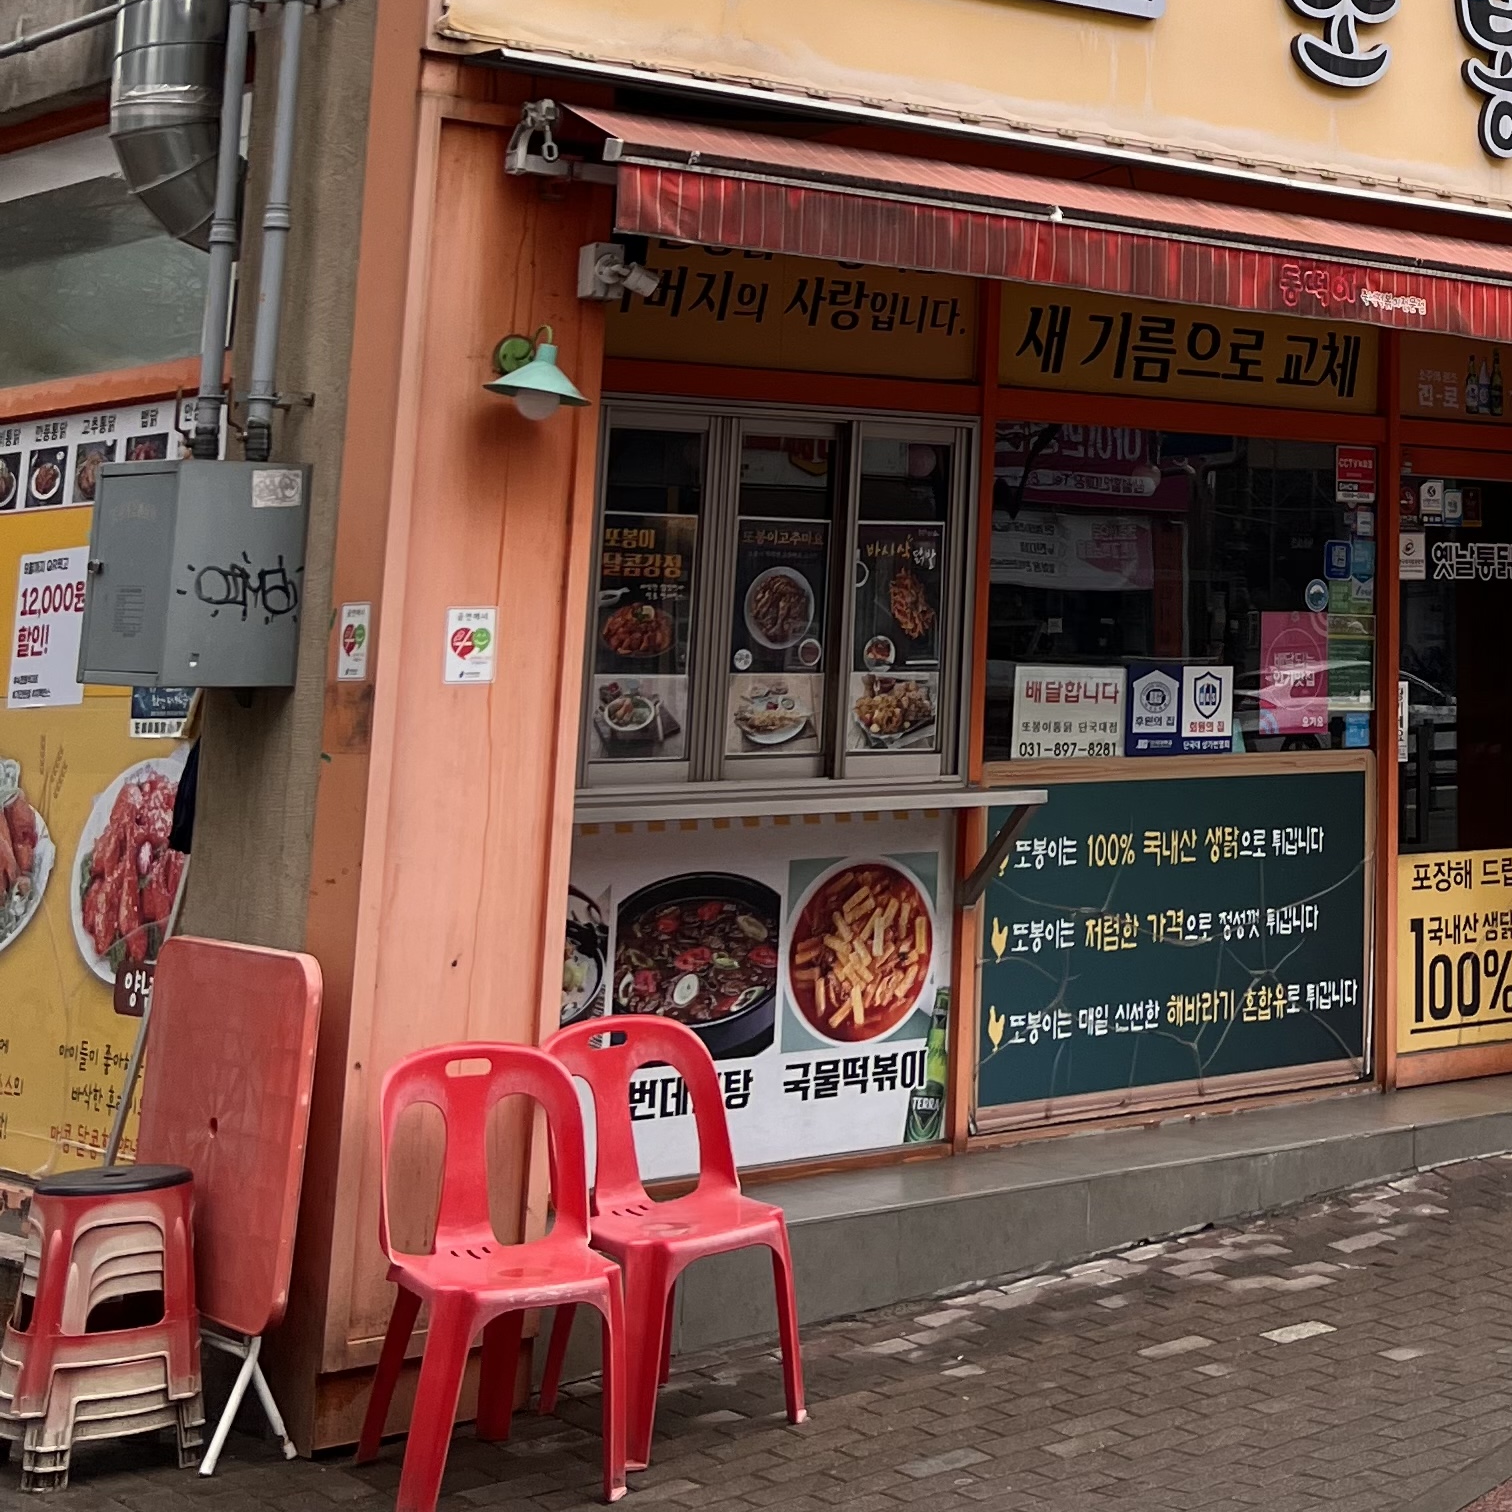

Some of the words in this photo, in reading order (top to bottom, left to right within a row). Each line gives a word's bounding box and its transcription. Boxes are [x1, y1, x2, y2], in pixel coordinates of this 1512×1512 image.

[783, 274, 967, 337] 사랑입니다.
[1015, 303, 1071, 375] 새
[1080, 311, 1267, 385] 기름으로
[1275, 329, 1362, 400] 교체
[604, 528, 656, 549] 또봉이
[20, 580, 86, 618] 12,000원
[16, 623, 50, 659] 할인!
[1024, 679, 1120, 705] 배달합니다
[1078, 720, 1119, 735] 단국대점
[1165, 715, 1176, 728] 집
[1301, 715, 1325, 729] 요기요
[1018, 741, 1118, 759] 031-897-8281
[1014, 836, 1079, 870] 또봉이는
[1086, 832, 1136, 868] 100%
[1142, 828, 1198, 867] 국내산
[1203, 824, 1267, 864] 생닭으로
[1271, 824, 1325, 856] 튀깁니다
[1411, 858, 1473, 893] 포장해
[1010, 917, 1076, 954] 또봉이는
[1084, 911, 1140, 952] 저렴한
[1146, 908, 1213, 944] 가격으로
[1218, 908, 1261, 941] 정성껏
[1265, 904, 1320, 937] 튀깁니다
[1427, 911, 1480, 947] 국내산
[1008, 1008, 1073, 1045] 또봉이는
[1078, 1004, 1110, 1037] 매일
[1114, 998, 1161, 1034] 신선한
[1165, 988, 1236, 1027] 해바라기
[1242, 983, 1302, 1024] 혼합유로
[1305, 978, 1359, 1012] 튀깁니다
[58, 1039, 100, 1073] 아이들이
[628, 1067, 754, 1123] 번데탕
[782, 1049, 928, 1102] 국물떡볶이
[911, 1094, 942, 1113] TERRA
